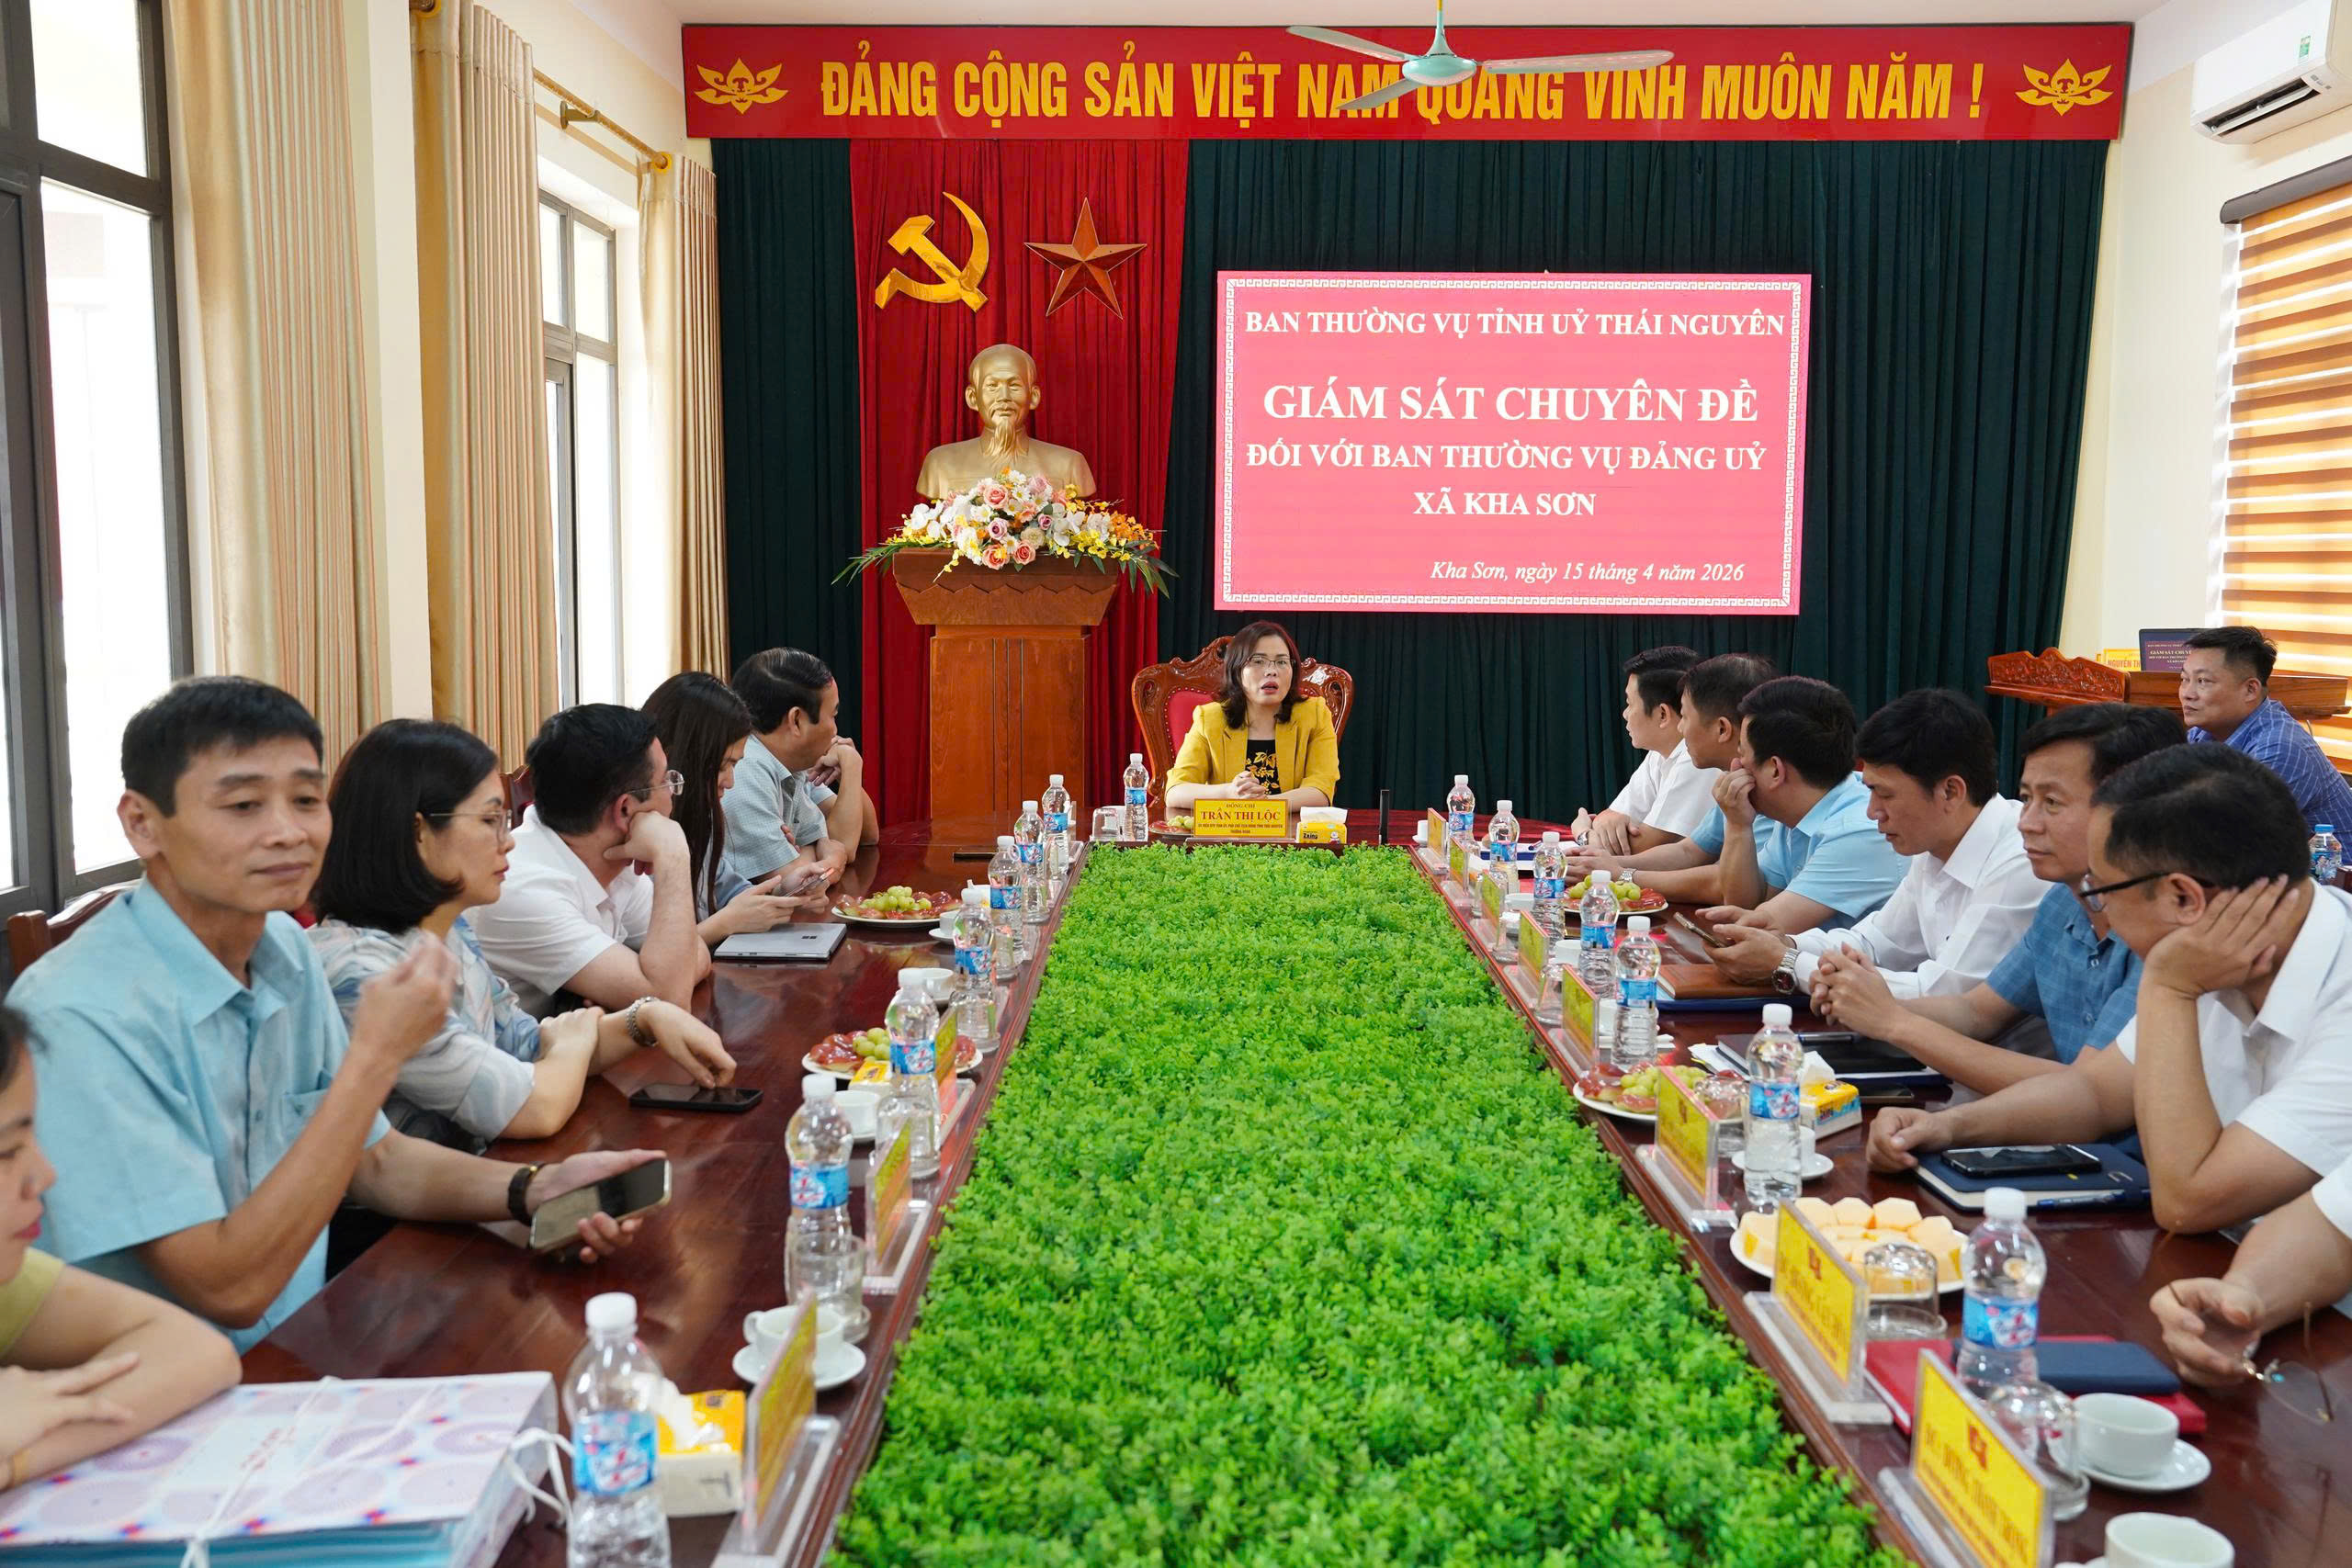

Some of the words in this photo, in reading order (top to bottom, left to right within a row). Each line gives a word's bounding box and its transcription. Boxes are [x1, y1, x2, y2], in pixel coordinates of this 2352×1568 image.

[820, 40, 937, 117] ĐẢNG
[954, 50, 1067, 129] CỘNG
[1084, 40, 1174, 118] SẢN
[1191, 51, 1281, 129] VIỆT
[1296, 63, 1400, 119] NAM
[1416, 67, 1565, 125] QUANG
[1583, 63, 1687, 120] VINH
[1701, 51, 1832, 120] MUÔN
[1846, 51, 1953, 119] NĂM
[1969, 62, 1984, 118] !
[1246, 311, 1301, 333] BAN
[1307, 307, 1426, 333] THƯỜNG
[1433, 312, 1471, 339] VỤ
[1477, 307, 1544, 334] TỈNH
[1552, 308, 1590, 335] UỶ
[1596, 308, 1664, 335] THÁI
[1669, 308, 1785, 336] NGUYÊN
[1263, 376, 1388, 419] GIÁM
[1399, 377, 1485, 420] SÁT
[1496, 378, 1688, 421] CHUYÊN
[1698, 378, 1758, 422] ĐỀ
[1246, 437, 1302, 467] ĐỐI
[1308, 438, 1364, 468] VỚI
[1371, 445, 1434, 468] BAN
[1441, 439, 1574, 469] THƯỜNG
[1580, 446, 1623, 475] VỤ
[1629, 441, 1717, 470] ĐẢNG
[1724, 441, 1768, 470] UỶ
[1413, 487, 1456, 515] XÃ
[1463, 491, 1531, 515] KHA
[1536, 491, 1597, 516] SƠN
[1430, 561, 1468, 580] Kha
[1472, 561, 1509, 582] Sơn,
[1515, 562, 1558, 584] ngày
[1562, 562, 1584, 580] 15
[1589, 562, 1639, 585] tháng
[1642, 563, 1655, 581] 4
[1658, 563, 1696, 581] năm
[1700, 563, 1746, 581] 2026
[1201, 807, 1232, 820] TRẦN
[1234, 810, 1255, 822] THỊ
[1256, 809, 1282, 822] LỘC
